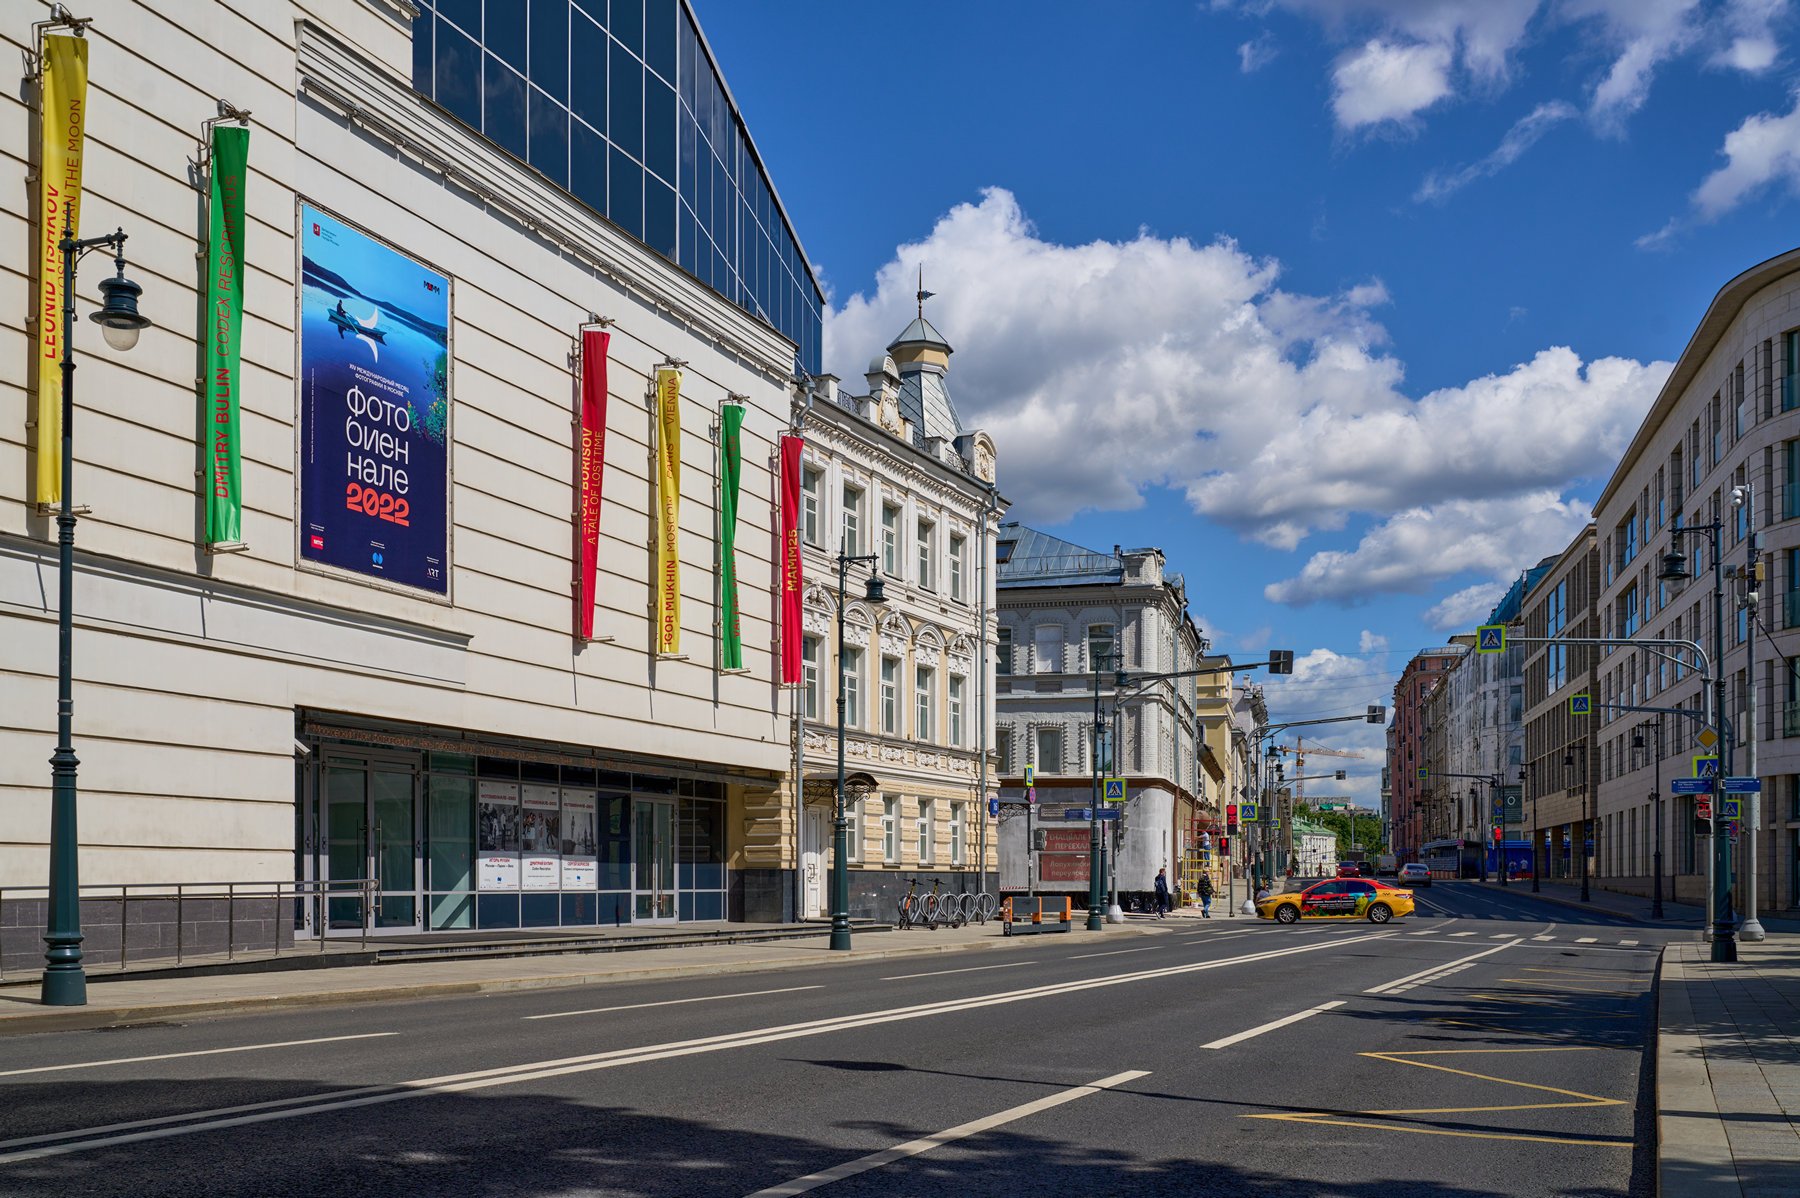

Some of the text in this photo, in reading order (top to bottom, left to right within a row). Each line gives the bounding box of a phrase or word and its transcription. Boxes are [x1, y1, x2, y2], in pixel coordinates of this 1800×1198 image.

[67, 99, 81, 152] MOON
[64, 158, 79, 190] THE
[214, 175, 238, 498] DMITRY BULIN CODEX RESCRIPTUS
[665, 377, 676, 425] VIENNA
[346, 415, 409, 465] биен
[582, 427, 592, 490] BORISOV
[593, 430, 603, 456] TIME
[347, 452, 409, 495] нале
[591, 458, 601, 487] LOST
[346, 482, 410, 527] 2022
[590, 490, 599, 505] OF
[588, 508, 598, 534] TALE
[787, 529, 797, 592] MAMM25
[665, 560, 675, 611] MUKHIN
[664, 615, 673, 646] IGOR
